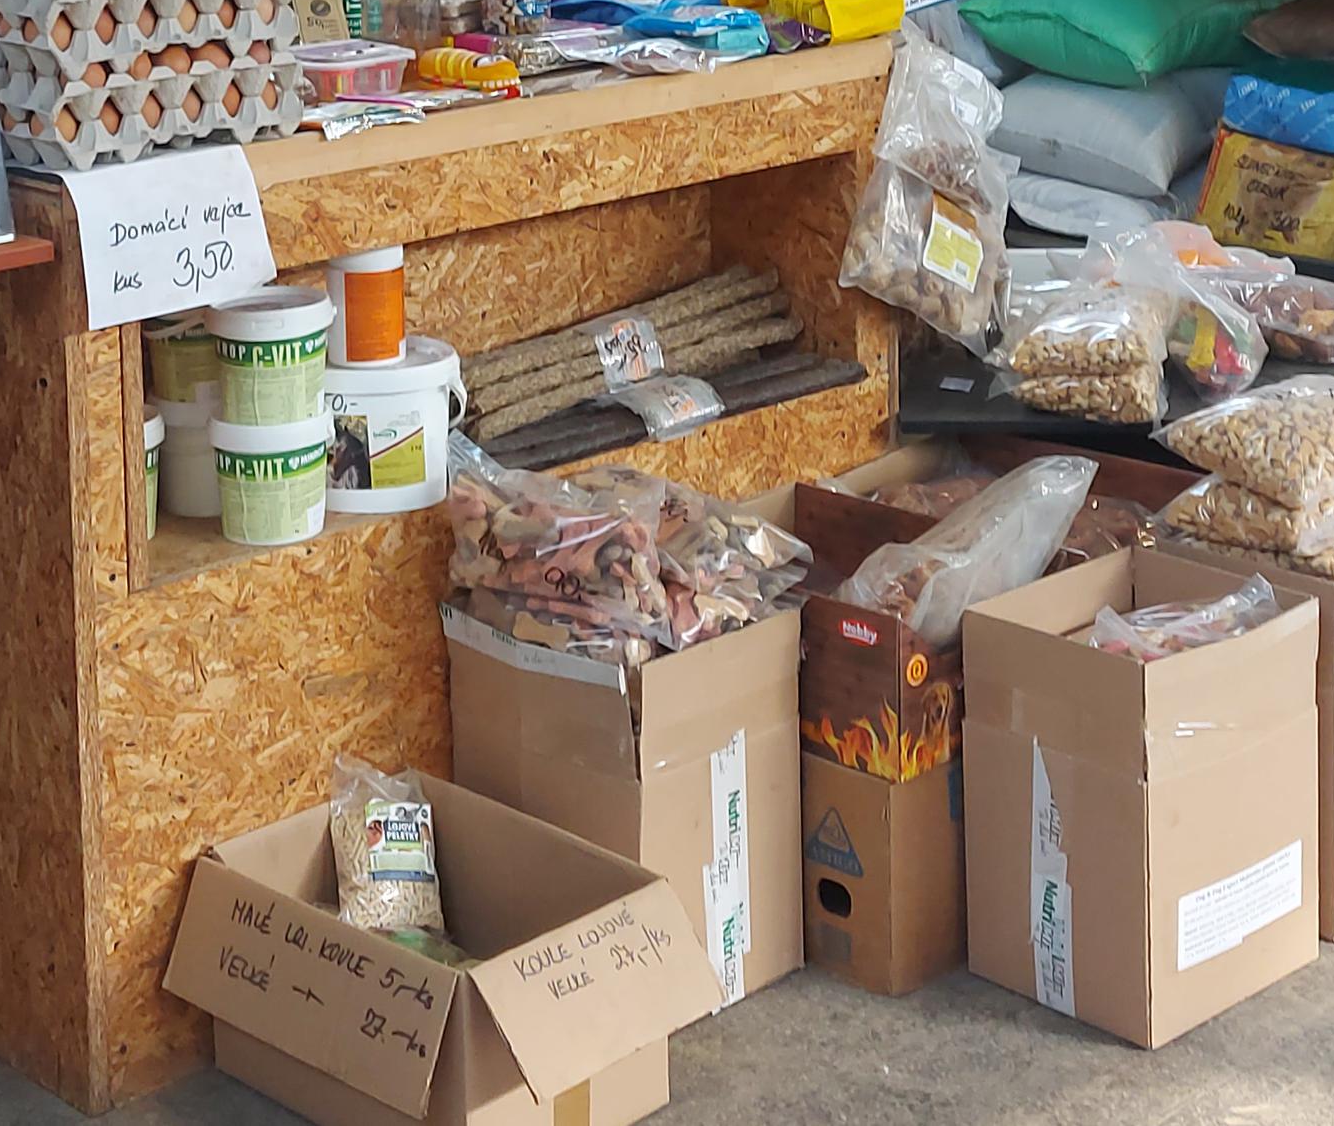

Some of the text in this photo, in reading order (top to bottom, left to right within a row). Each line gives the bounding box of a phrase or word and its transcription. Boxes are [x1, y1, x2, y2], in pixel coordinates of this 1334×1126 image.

[113, 271, 143, 294] kus
[252, 341, 303, 368] C-VIT
[235, 457, 285, 483] C-VIT
[842, 620, 878, 645] Nobby
[512, 900, 636, 983] KOULE LOJOVÉ
[318, 937, 376, 979] KOULE
